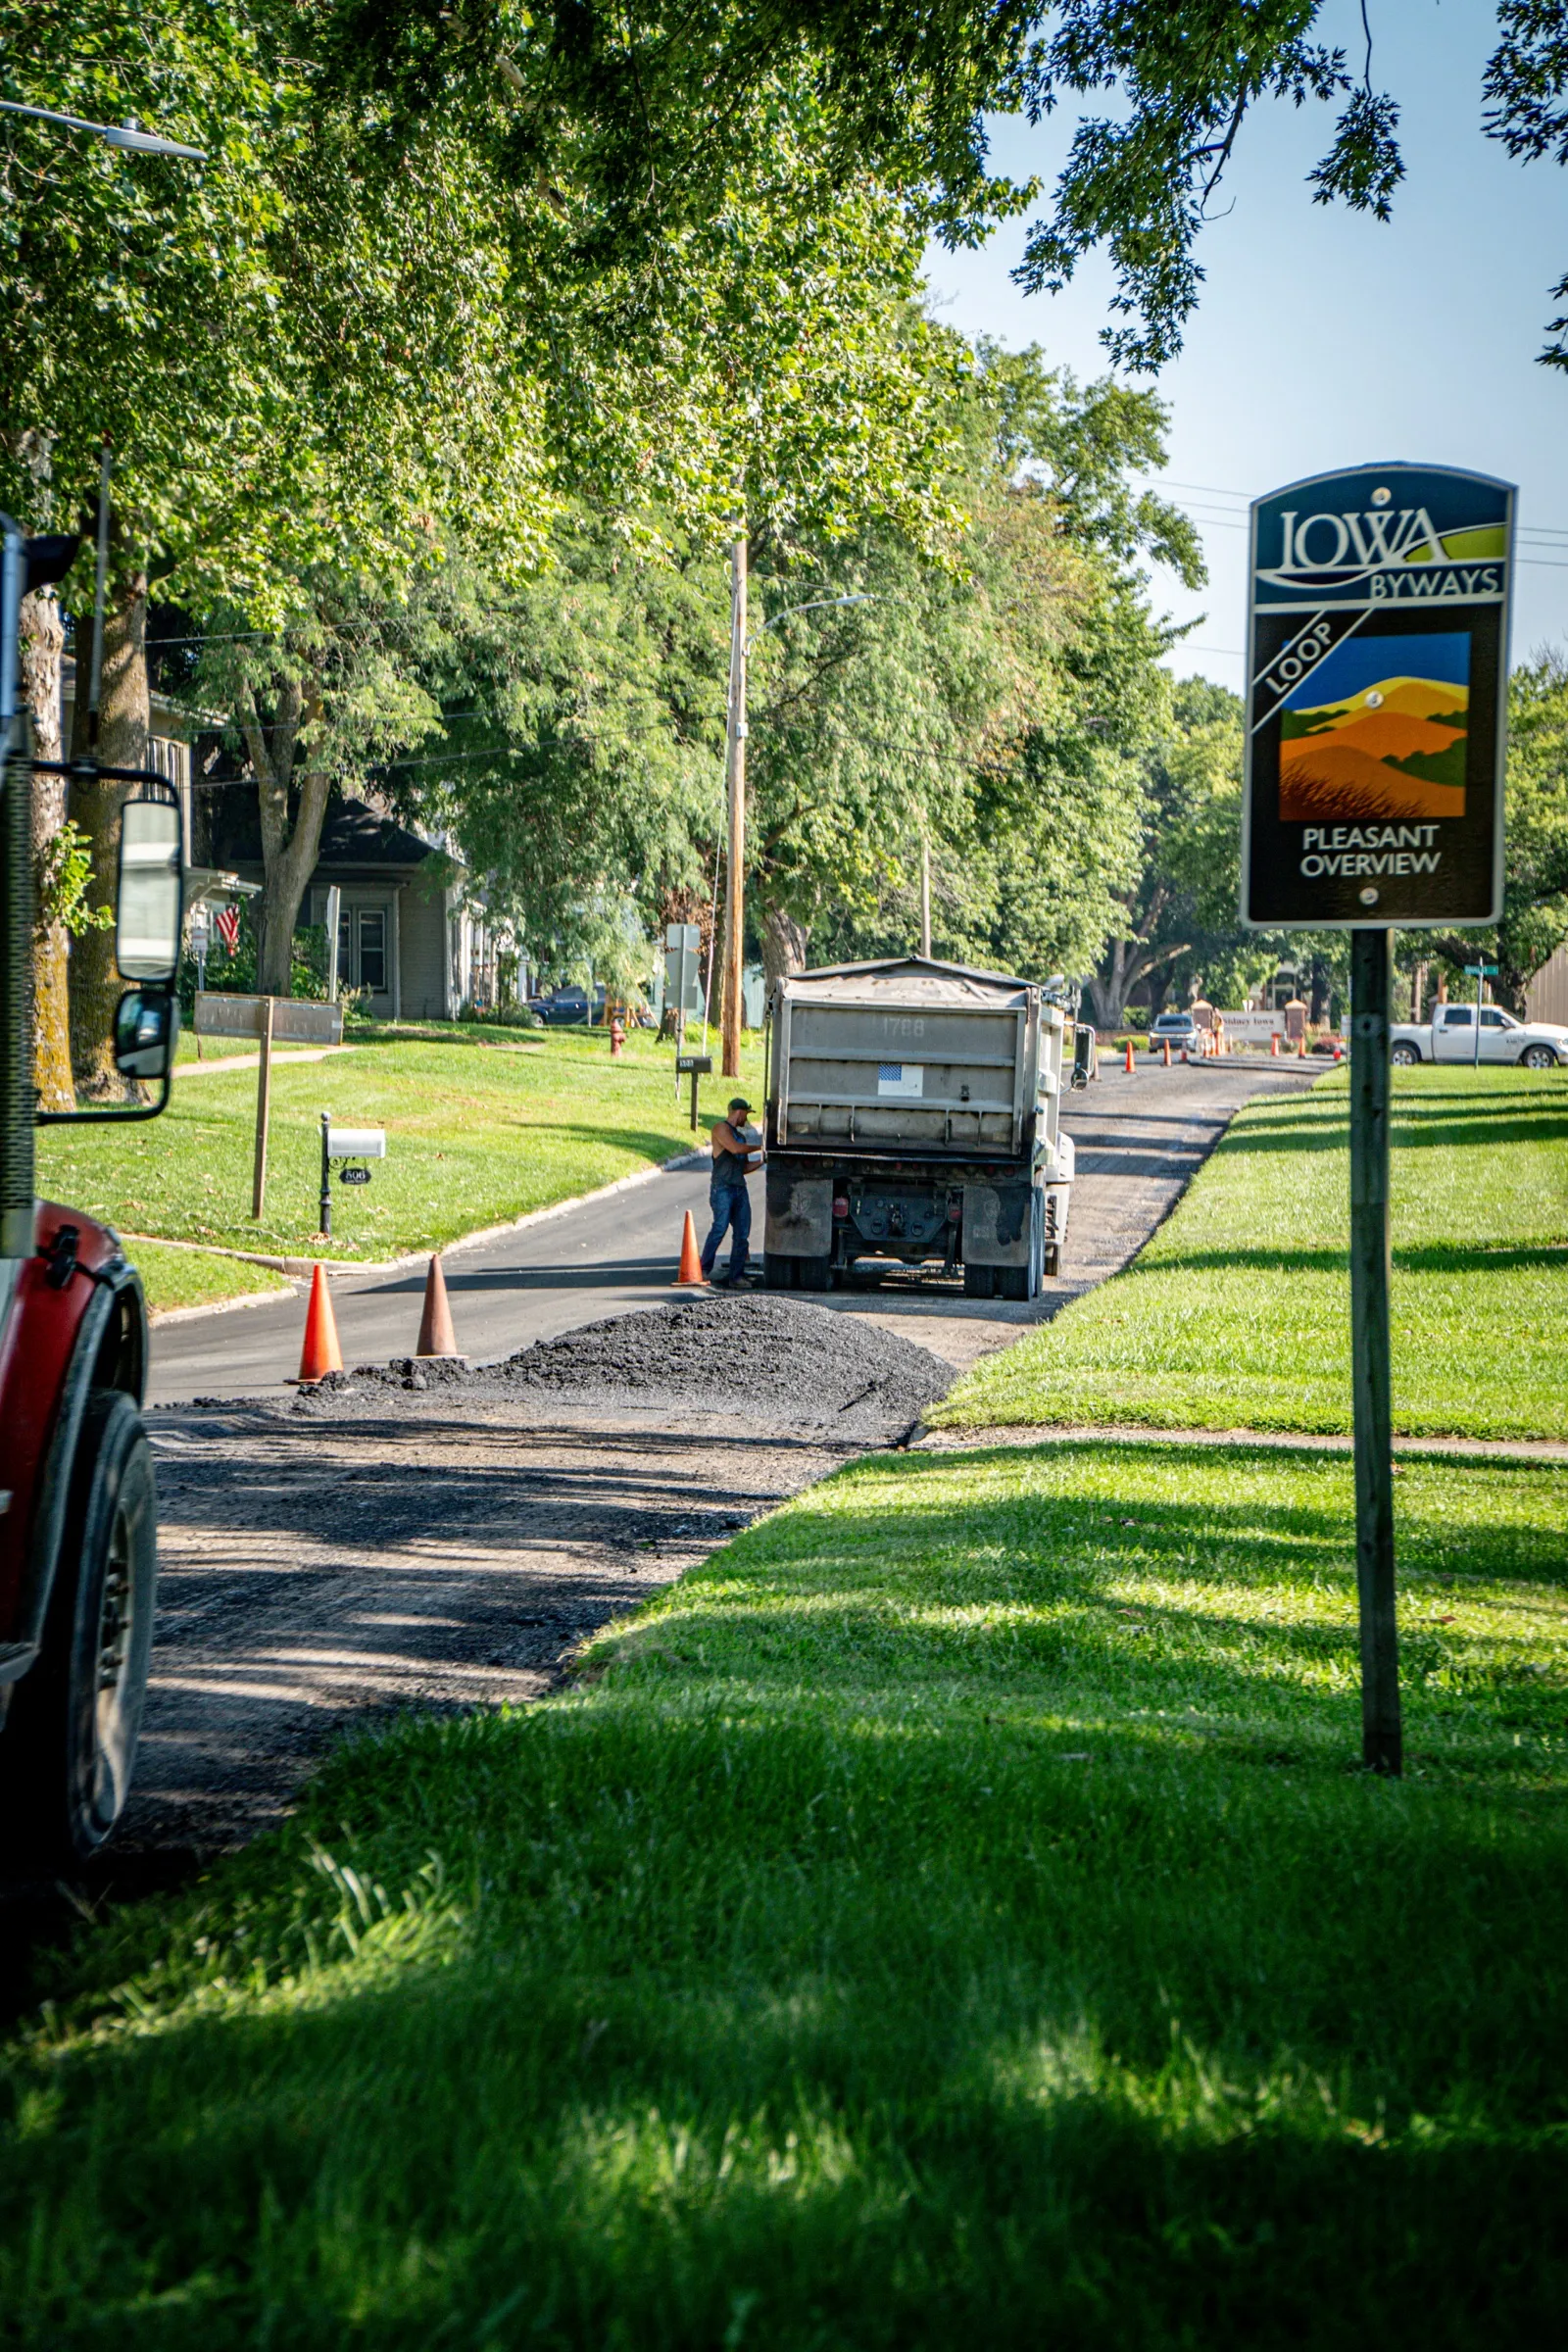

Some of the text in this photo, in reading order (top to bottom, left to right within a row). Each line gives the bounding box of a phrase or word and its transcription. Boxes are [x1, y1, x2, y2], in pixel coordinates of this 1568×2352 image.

[1280, 507, 1451, 569] IOWA
[1370, 567, 1499, 600] BYWAYS
[1265, 622, 1332, 695] LOOP
[1302, 824, 1441, 851] PLEASANT
[1299, 852, 1442, 878] OVERVIEW
